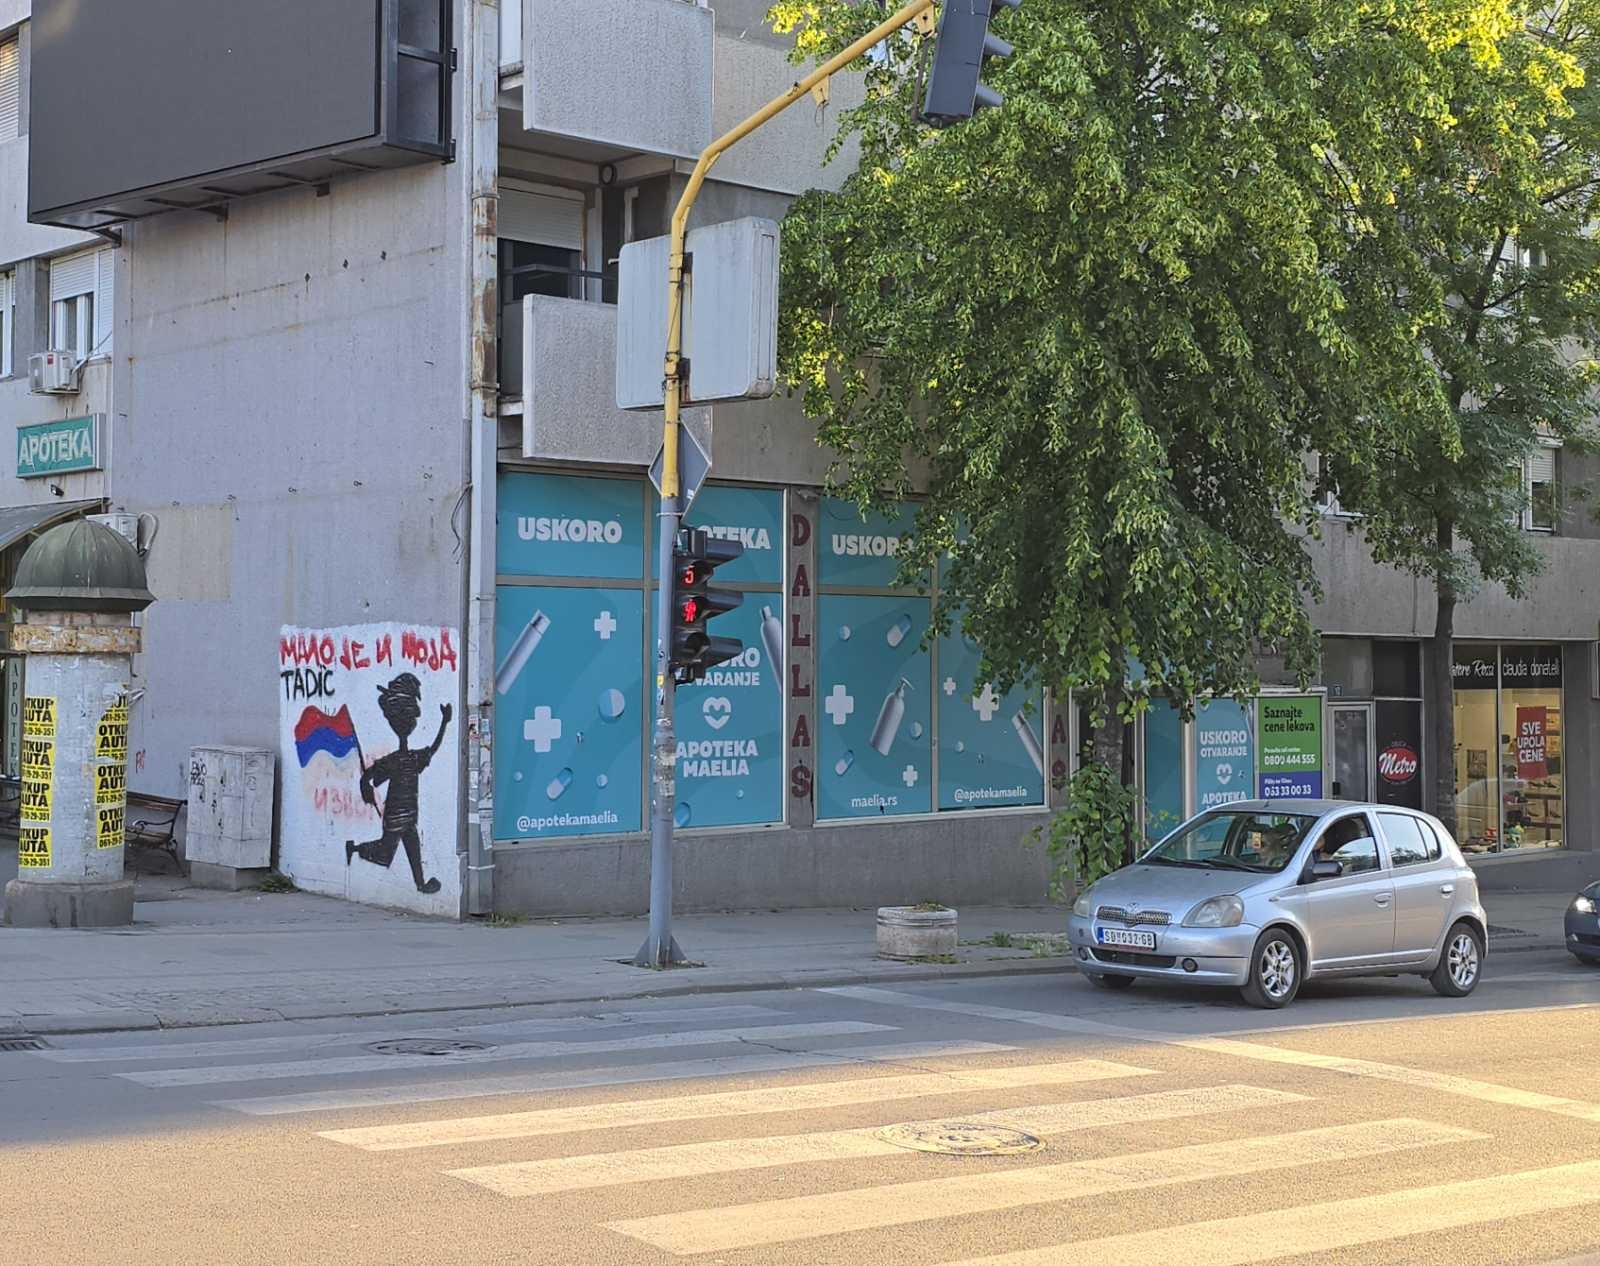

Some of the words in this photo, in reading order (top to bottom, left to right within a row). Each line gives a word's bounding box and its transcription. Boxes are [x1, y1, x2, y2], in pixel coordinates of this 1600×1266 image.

[19, 428, 92, 466] APOTEKA
[518, 517, 622, 543] USKORO
[832, 534, 913, 556] USKOR
[791, 513, 812, 798] DALLAS
[24, 698, 54, 709] TKUP
[1264, 706, 1303, 720] Saznajte
[10, 663, 19, 778] APOTEK
[1264, 722, 1285, 732] cene
[1286, 720, 1315, 732] lekova
[98, 724, 128, 736] OTKU
[1521, 722, 1541, 735] SVE
[1200, 730, 1247, 745] USKORO
[1517, 736, 1545, 748] UPOLA
[23, 740, 52, 753] TKUP
[676, 739, 758, 758] APOTEKA
[1200, 746, 1248, 758] OTVARANJE
[1519, 749, 1544, 762] CENE
[683, 759, 749, 778] MAELIA
[1379, 752, 1416, 775] Metro
[98, 765, 127, 777] OTKU
[21, 781, 50, 794] TKUP
[954, 786, 1027, 803] @apotekamaelia
[851, 793, 898, 808] maelia.rs
[1202, 791, 1248, 804] APOTEKA
[101, 819, 123, 834] AUT
[516, 810, 618, 832] @apotekamaelia
[20, 828, 48, 840] TKUP
